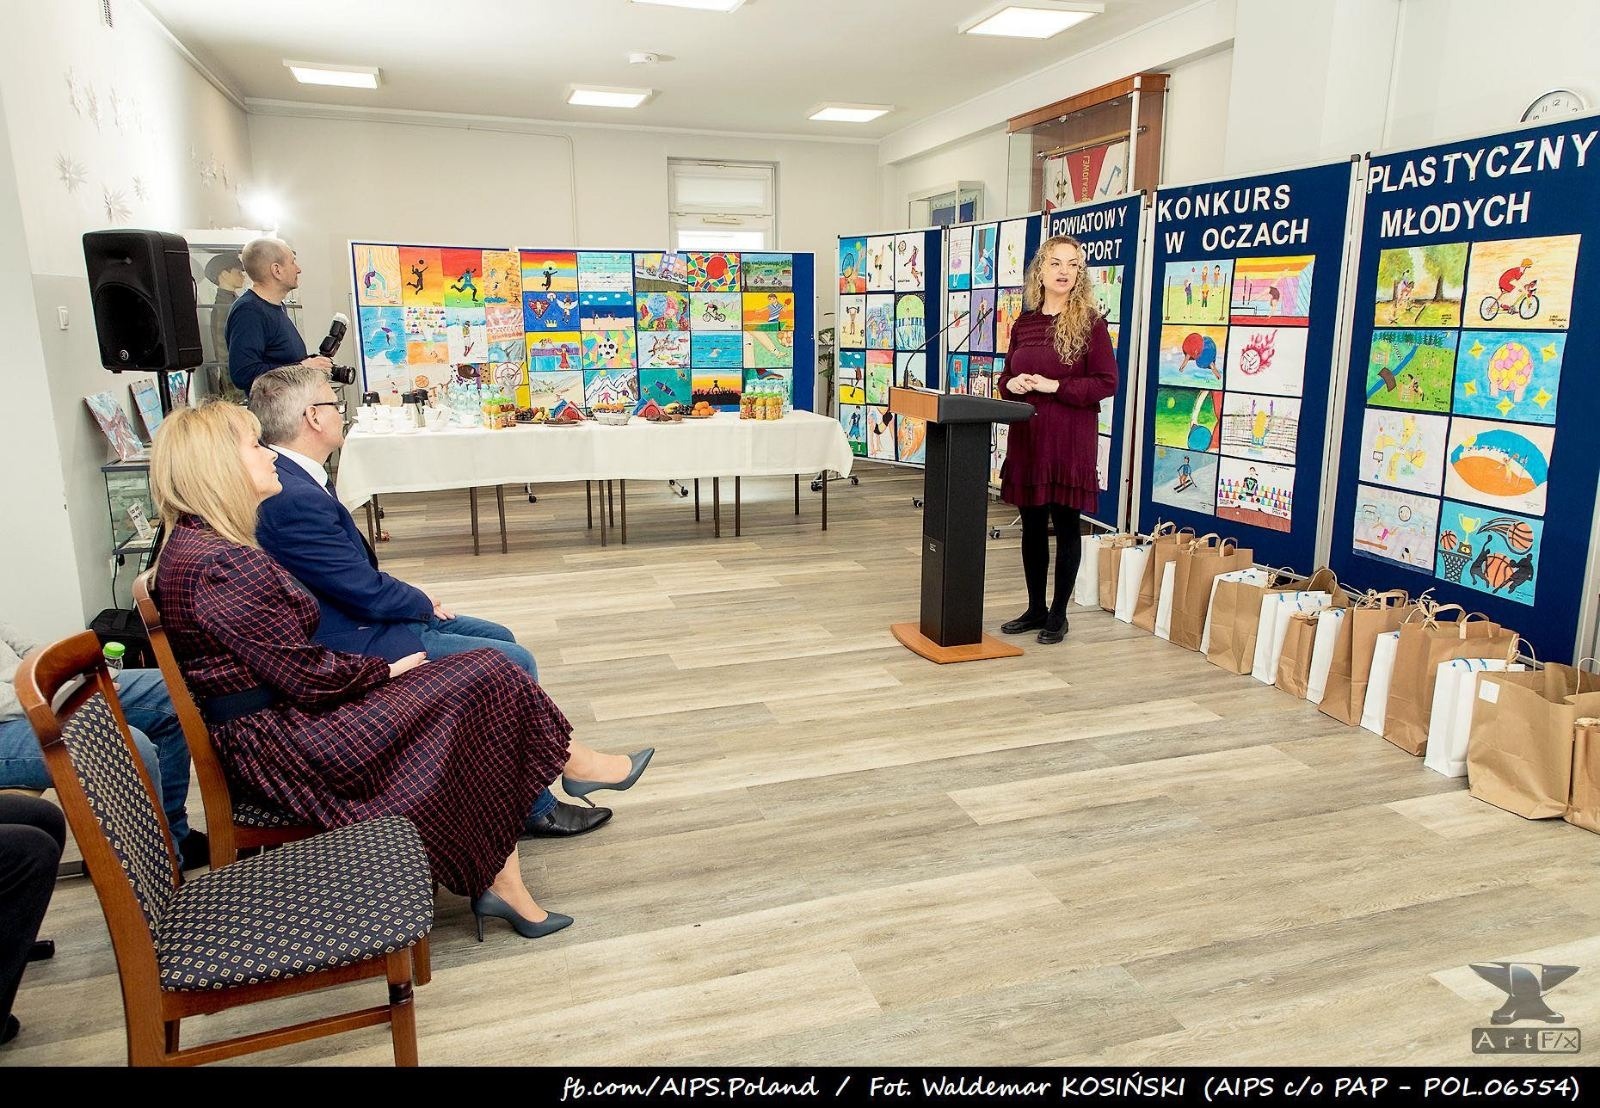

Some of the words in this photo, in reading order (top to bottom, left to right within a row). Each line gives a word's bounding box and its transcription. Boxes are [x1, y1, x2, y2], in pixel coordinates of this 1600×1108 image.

[1367, 130, 1599, 194] PLASTYCZNY
[1052, 205, 1128, 237] POWIATOWY
[1157, 184, 1291, 223] KONKURS
[1380, 191, 1532, 238] MŁODYCH
[1081, 239, 1123, 262] SPORT
[1165, 230, 1186, 254] W
[1202, 218, 1309, 251] OCZACH
